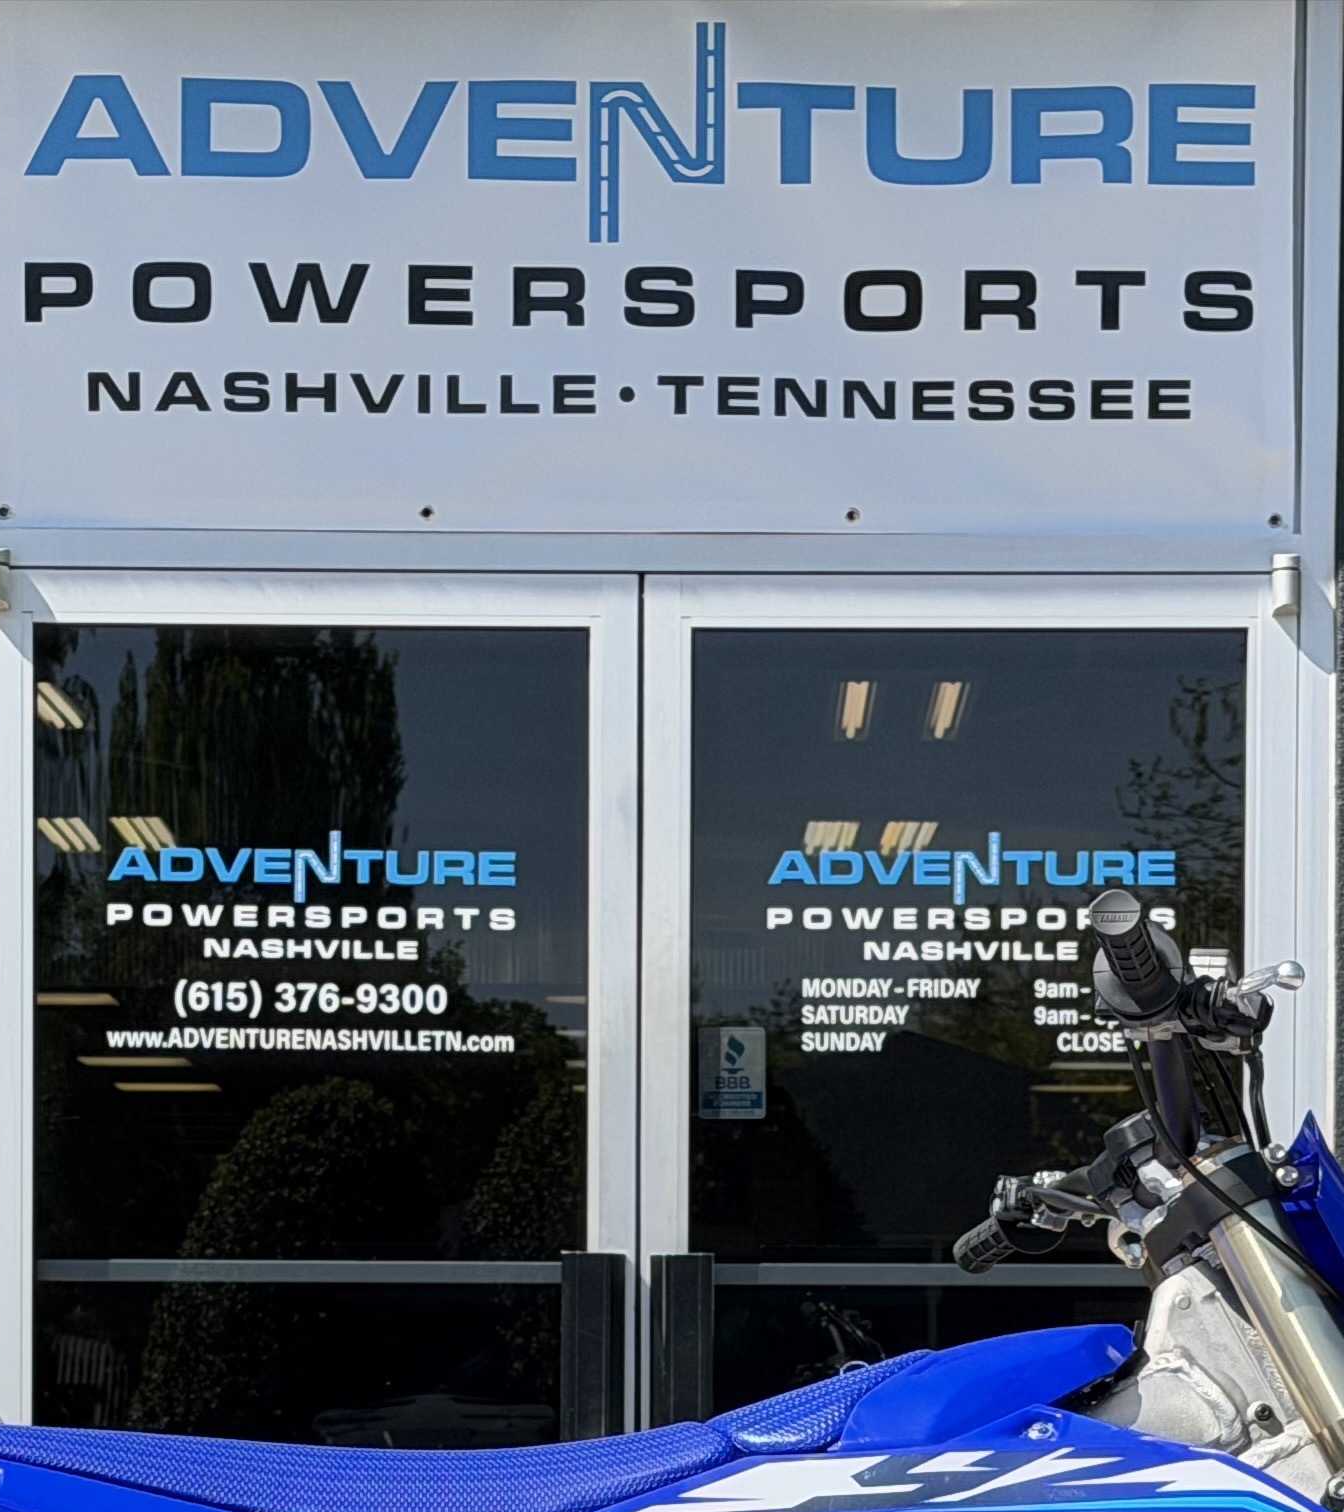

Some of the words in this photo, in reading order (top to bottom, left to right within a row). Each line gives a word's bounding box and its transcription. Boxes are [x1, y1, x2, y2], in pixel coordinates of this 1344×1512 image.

[24, 22, 1256, 243] ADVENTURE
[24, 261, 1255, 331] POWERSPORTS
[107, 830, 516, 903] ADVENTURE
[767, 832, 1176, 904] ADVENTURE
[106, 904, 516, 931] POWERSPORTS
[203, 938, 419, 960] NASHVILLE
[863, 941, 1078, 961] NASHVILLE
[174, 978, 262, 1018] (615)
[275, 982, 448, 1015] 376-9300
[802, 1005, 909, 1025] SATURDAY
[106, 1028, 514, 1053] www.ADVENTURENASHVILLETN.com
[802, 1032, 885, 1052] SUNDAY
[1057, 1032, 1141, 1052] CLOSE
[715, 1076, 751, 1089] BBB
